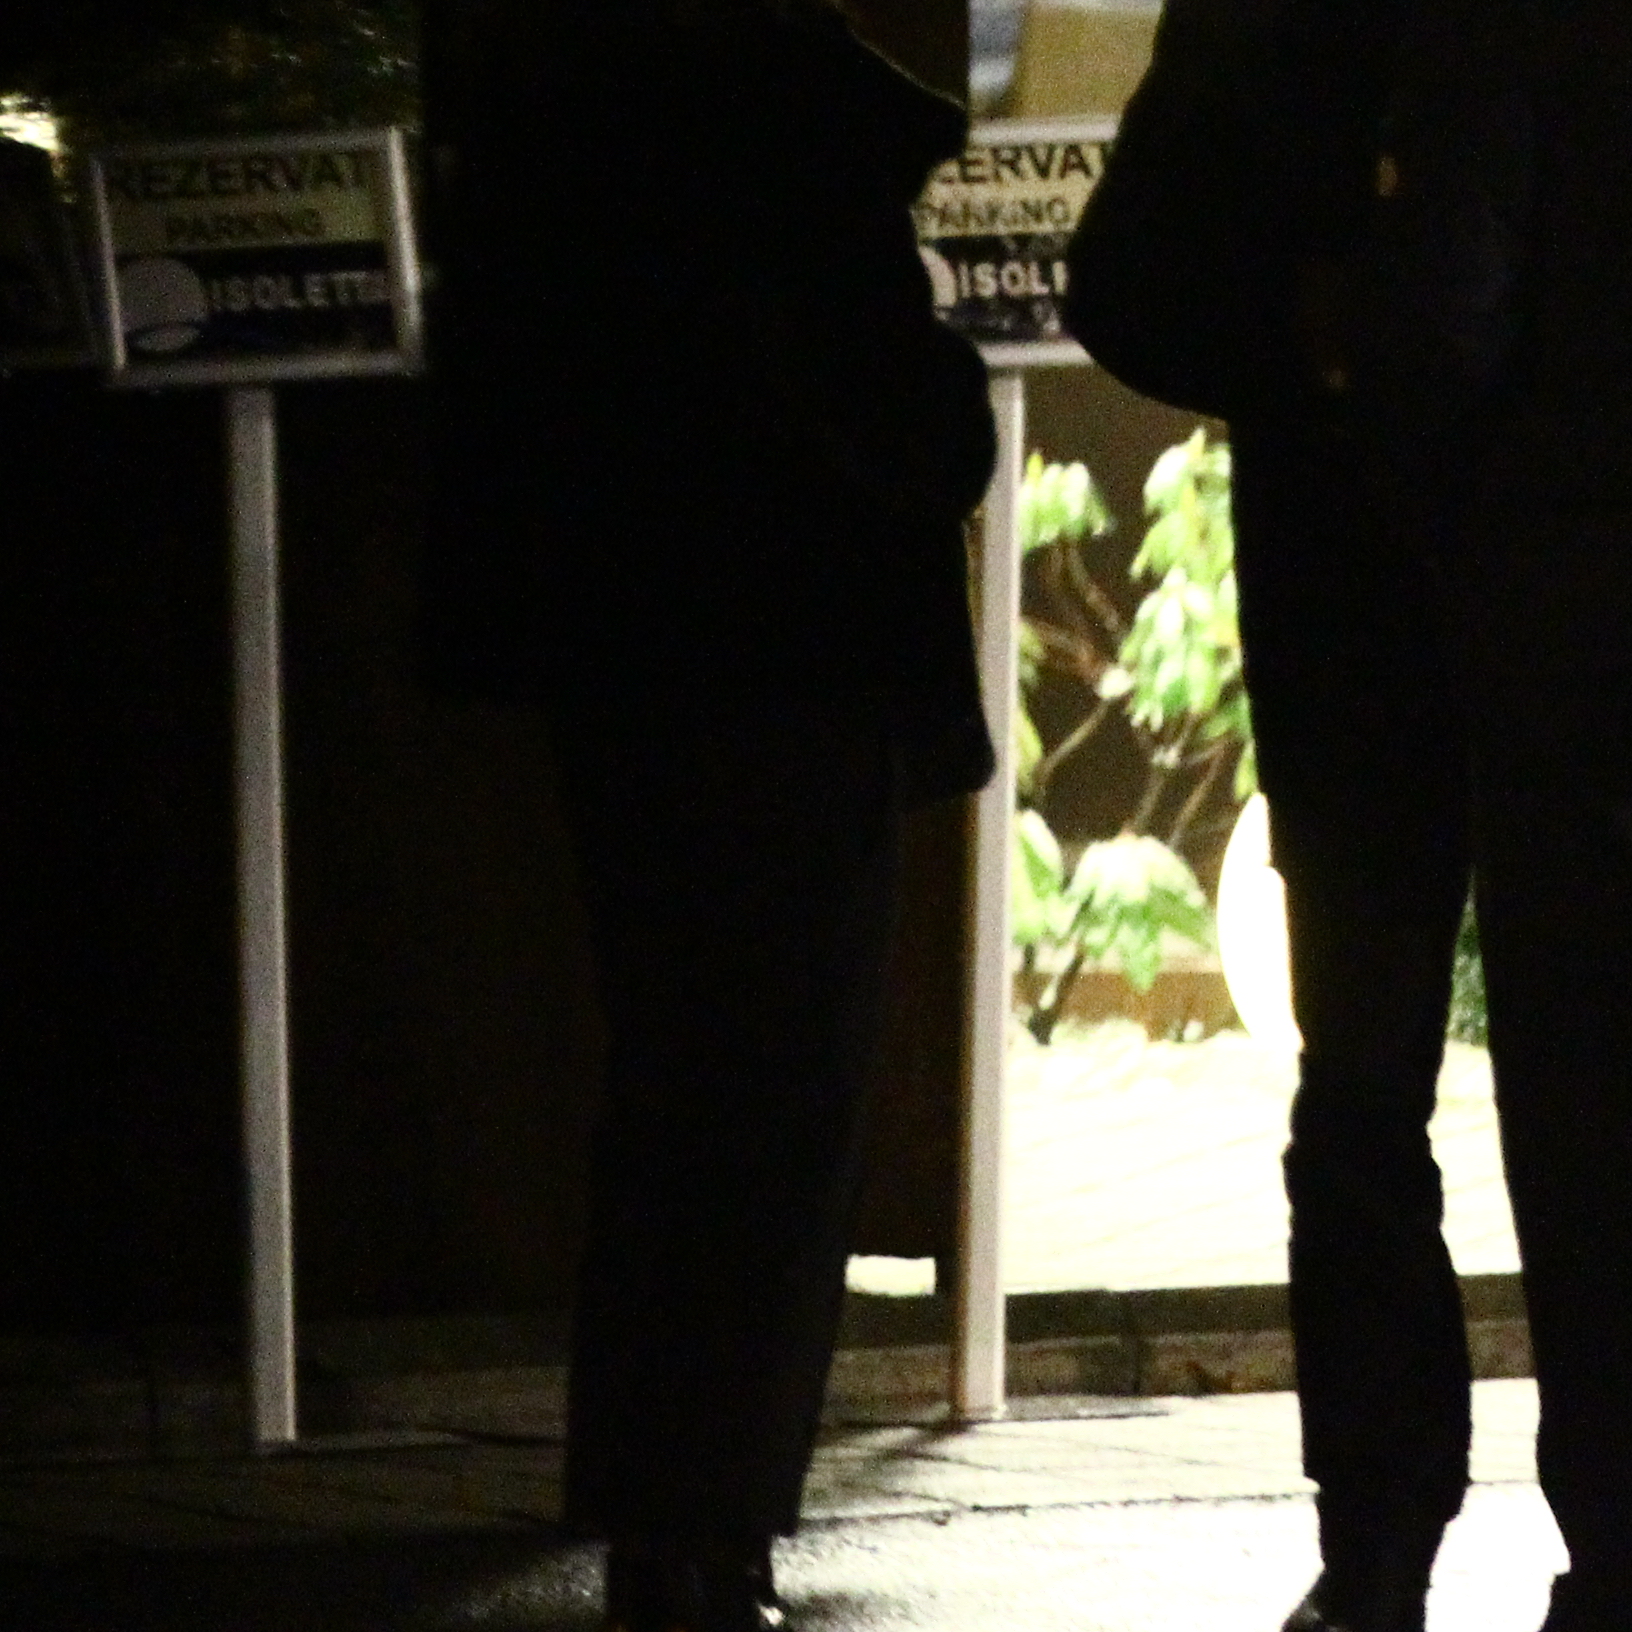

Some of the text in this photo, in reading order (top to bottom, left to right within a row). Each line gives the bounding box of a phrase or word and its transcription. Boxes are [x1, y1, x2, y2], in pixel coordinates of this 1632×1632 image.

[108, 153, 370, 200] REZERVAT
[935, 143, 1108, 185] ERVA
[165, 208, 325, 244] PARKING
[208, 270, 388, 313] ISOLETT
